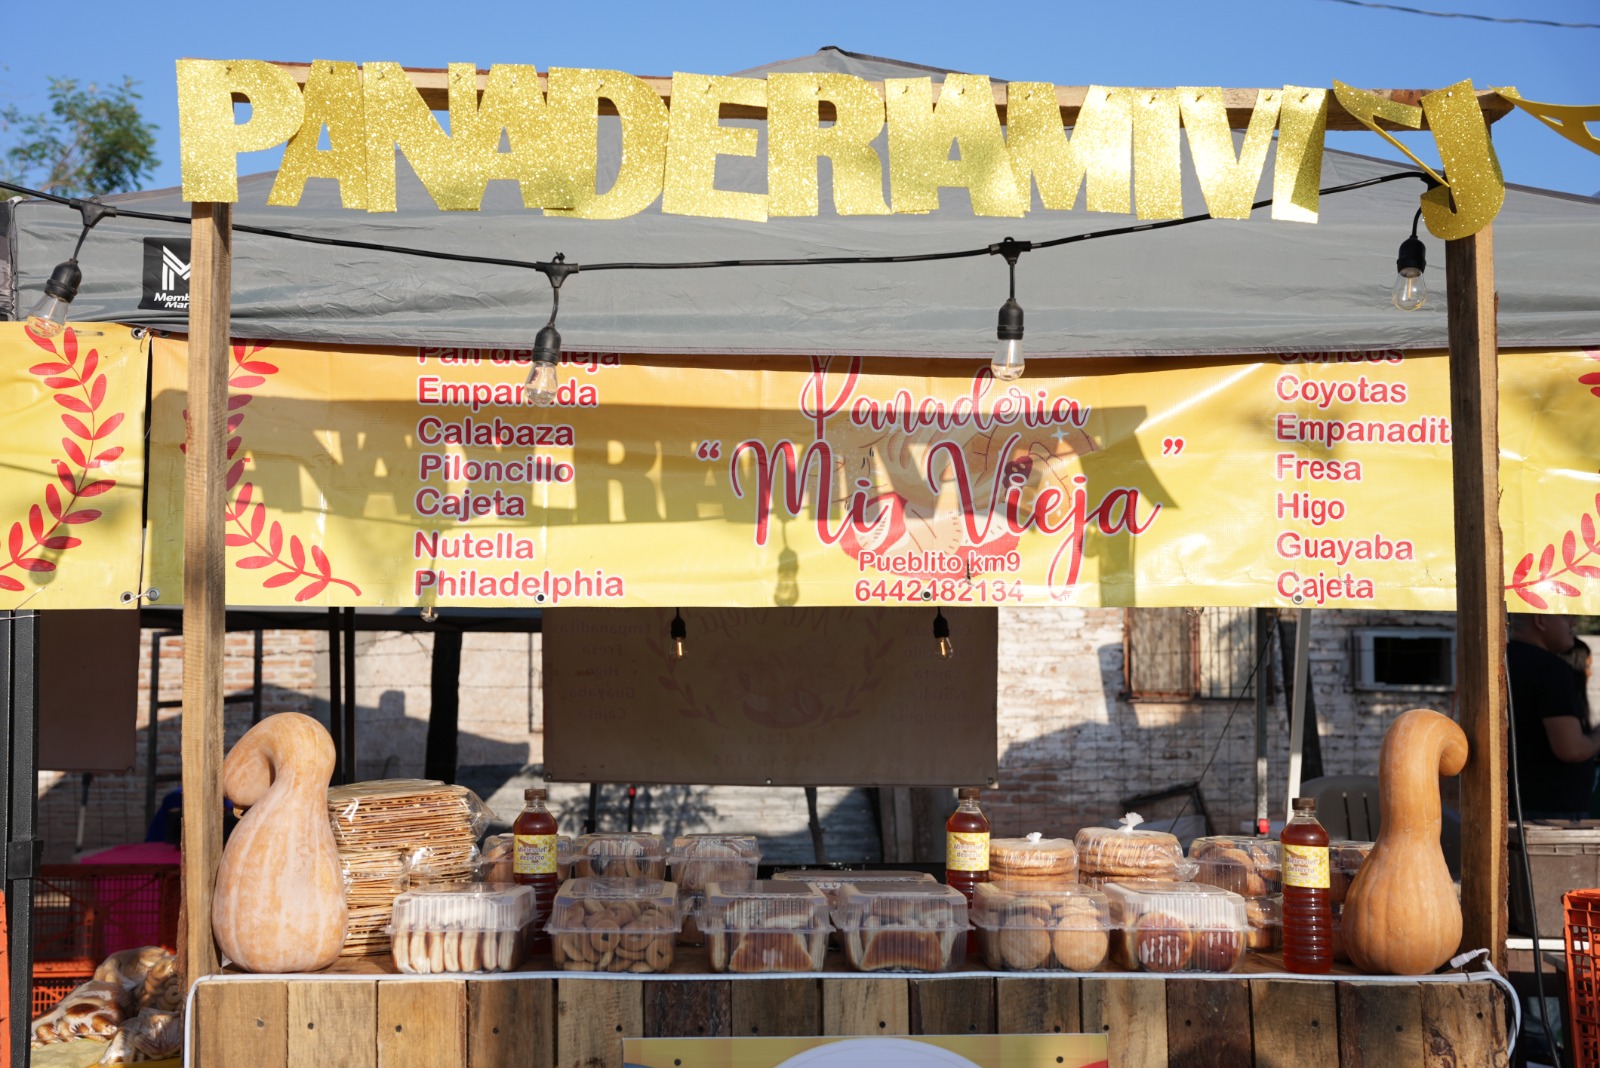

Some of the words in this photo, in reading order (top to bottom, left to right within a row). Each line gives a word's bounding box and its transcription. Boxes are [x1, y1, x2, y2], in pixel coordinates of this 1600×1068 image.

[418, 377, 598, 412] Empanda
[800, 354, 1090, 440] Panaderia
[1276, 374, 1408, 409] Coyotas
[417, 417, 575, 446] Calabaza
[1277, 414, 1452, 448] Empanadit
[420, 454, 575, 483] Piloncillo
[1276, 453, 1363, 482] Fresa
[415, 488, 526, 522] Cajeta
[1276, 492, 1346, 526] Higo
[414, 531, 535, 559] Nutella
[859, 551, 963, 573] Pueblito
[969, 551, 1021, 573] km9
[1276, 531, 1414, 567] Guayaba
[414, 570, 624, 604] Philadelphia
[854, 578, 1025, 602] 6442482134
[1276, 571, 1375, 605] Cajeta
